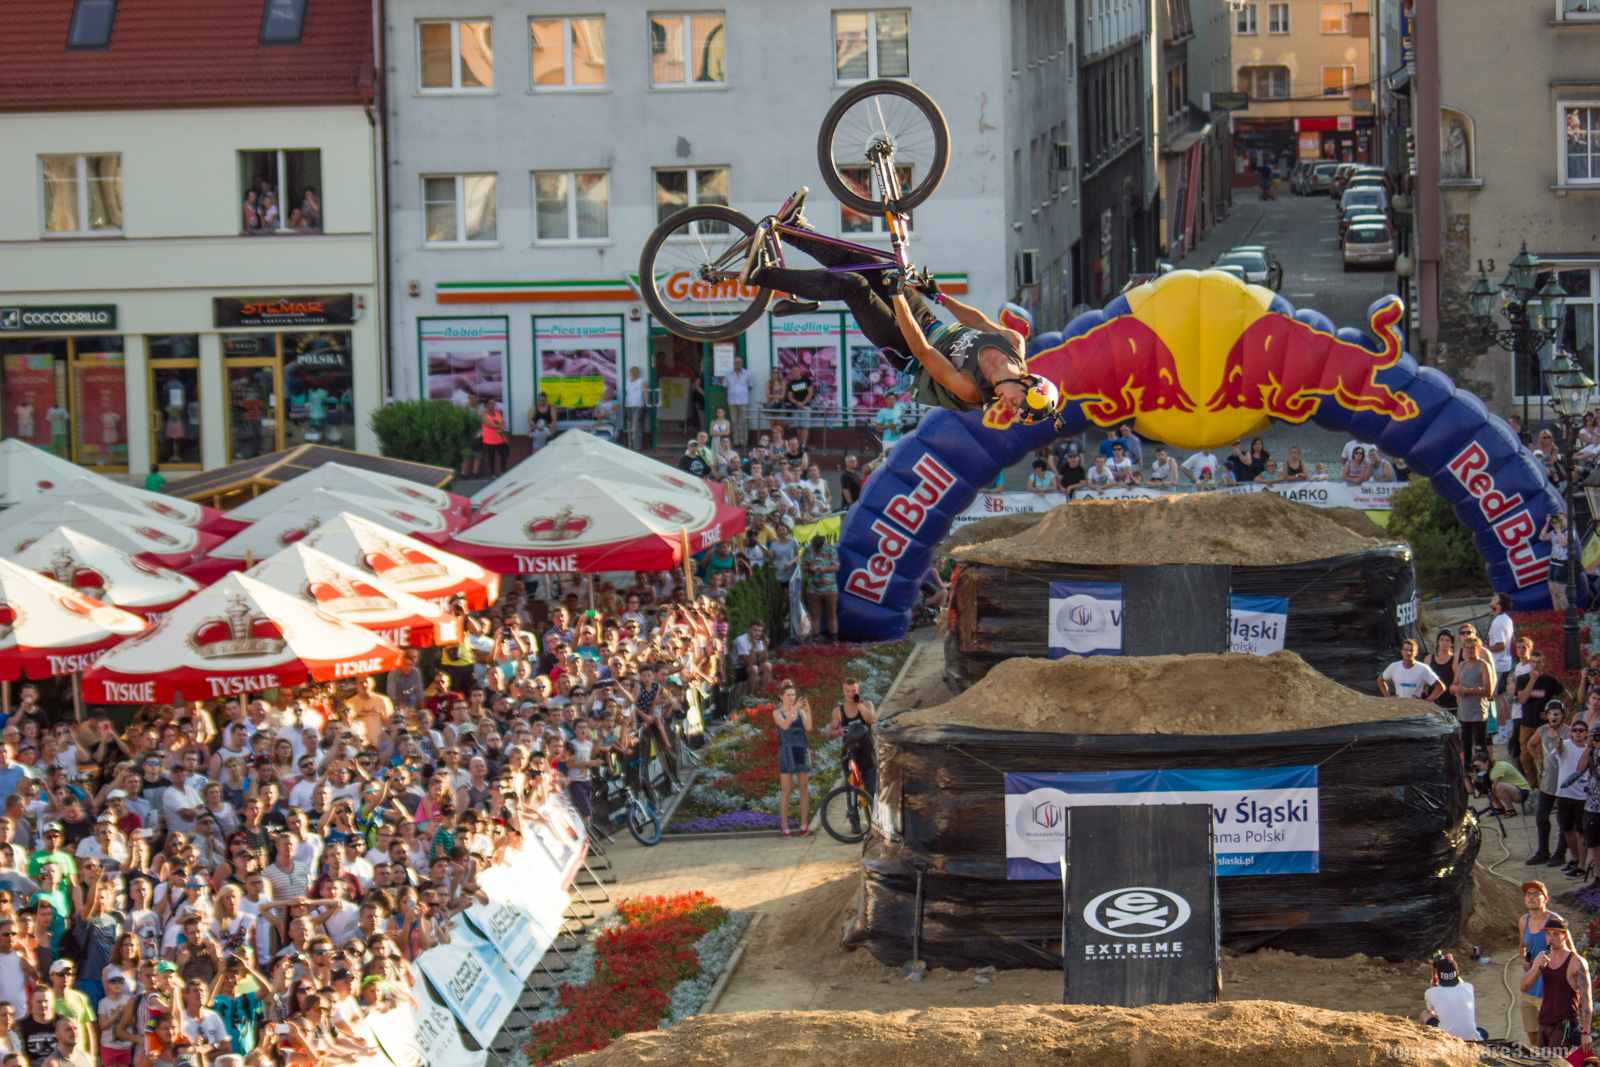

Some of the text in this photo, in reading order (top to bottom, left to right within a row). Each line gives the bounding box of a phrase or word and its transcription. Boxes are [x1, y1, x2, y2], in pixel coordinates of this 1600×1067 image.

[1477, 258, 1496, 273] 13
[666, 271, 760, 300] Gama
[241, 301, 324, 314] STEMAR
[23, 311, 108, 324] COCCODRILLO
[444, 326, 483, 337] Nabiał
[551, 325, 606, 337] Pieczywo
[783, 321, 829, 334] Wędliny
[993, 498, 1034, 513] BRYKIER
[1446, 440, 1550, 588] Red Bull
[701, 524, 721, 548] TYSKIE
[844, 453, 957, 604] Red Bull
[514, 554, 578, 572] TYSKIE
[1230, 617, 1278, 641] ląski
[102, 680, 156, 702] TYSKIE
[206, 673, 280, 696] TYSKIE
[1235, 796, 1308, 828] Śląski
[1245, 829, 1285, 843] Polski
[1085, 942, 1183, 955] EXTREME
